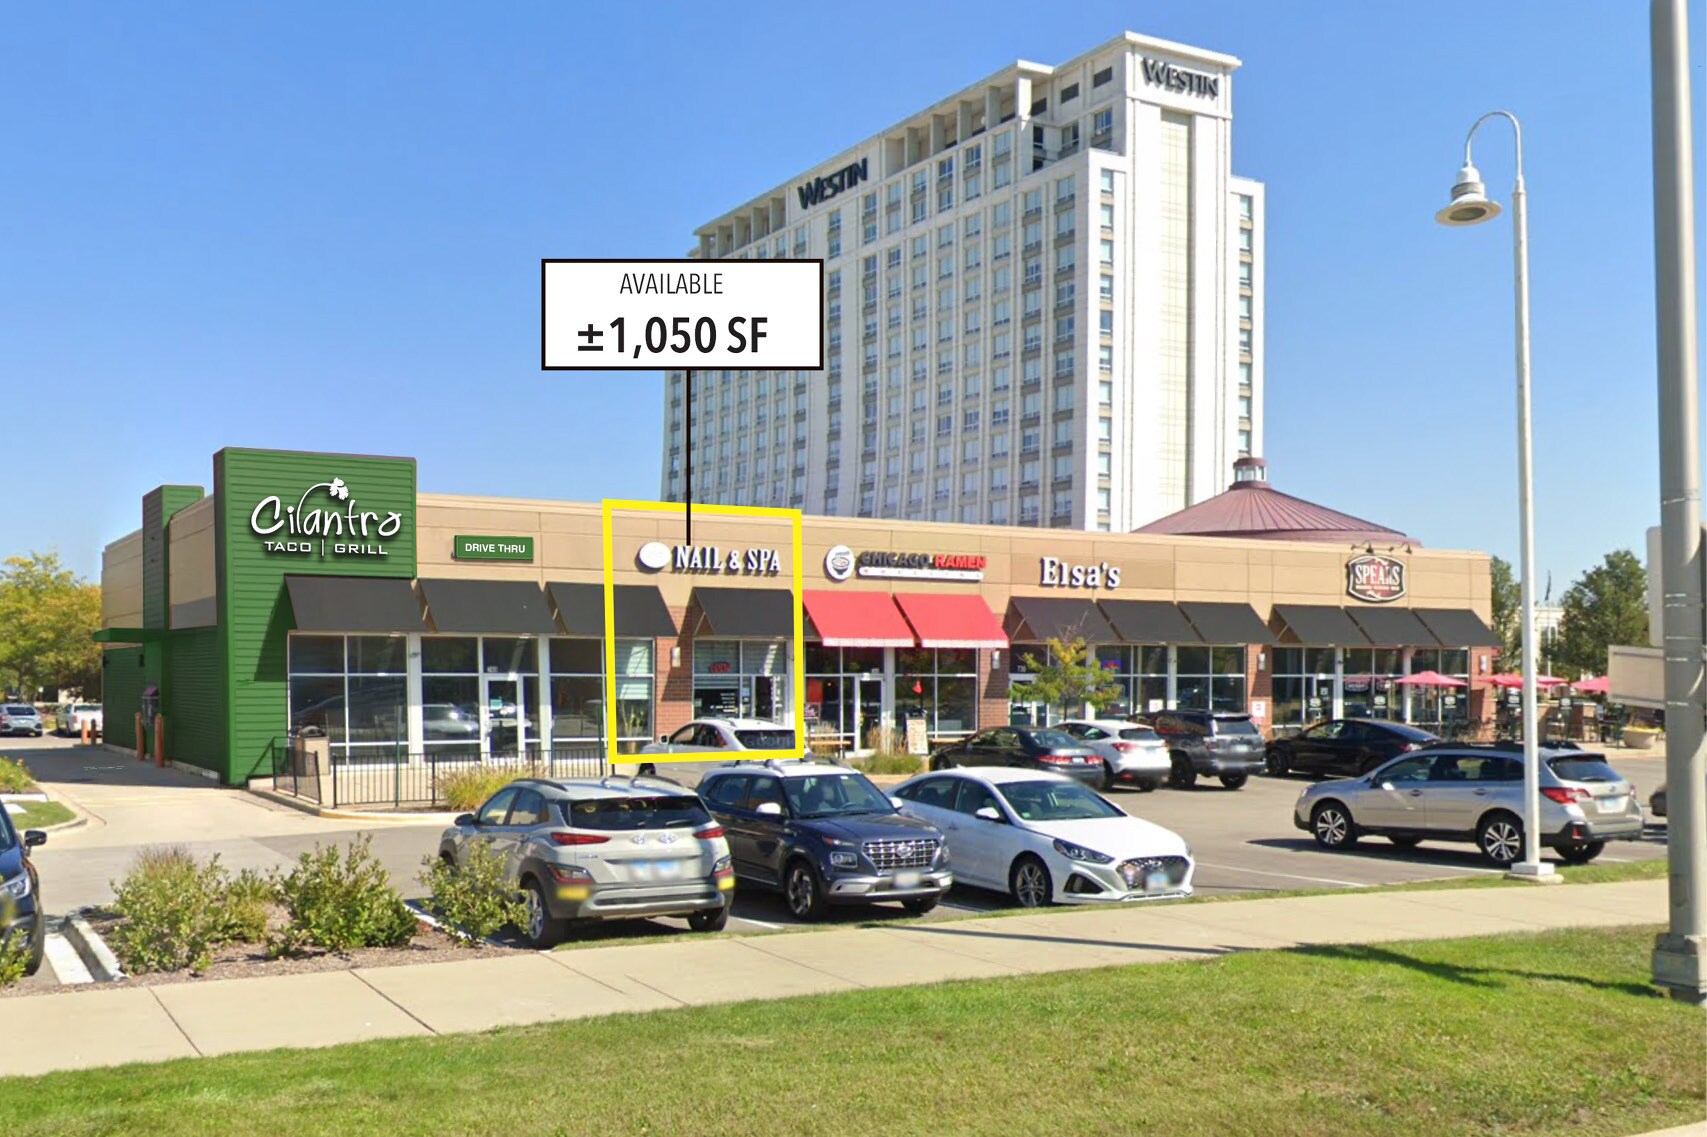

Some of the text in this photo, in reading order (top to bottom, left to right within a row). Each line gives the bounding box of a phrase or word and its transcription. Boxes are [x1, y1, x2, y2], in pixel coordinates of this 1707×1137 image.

[1141, 57, 1219, 100] WESTIN
[797, 157, 868, 210] WESTIN
[250, 482, 402, 537] Cilantro
[264, 541, 388, 555] TACO GRILL
[465, 543, 526, 554] DRIVE THRU
[674, 545, 782, 573] NAIL & SPA
[860, 551, 988, 570] CHICAGO RAMEN
[1040, 556, 1120, 588] Elsa's
